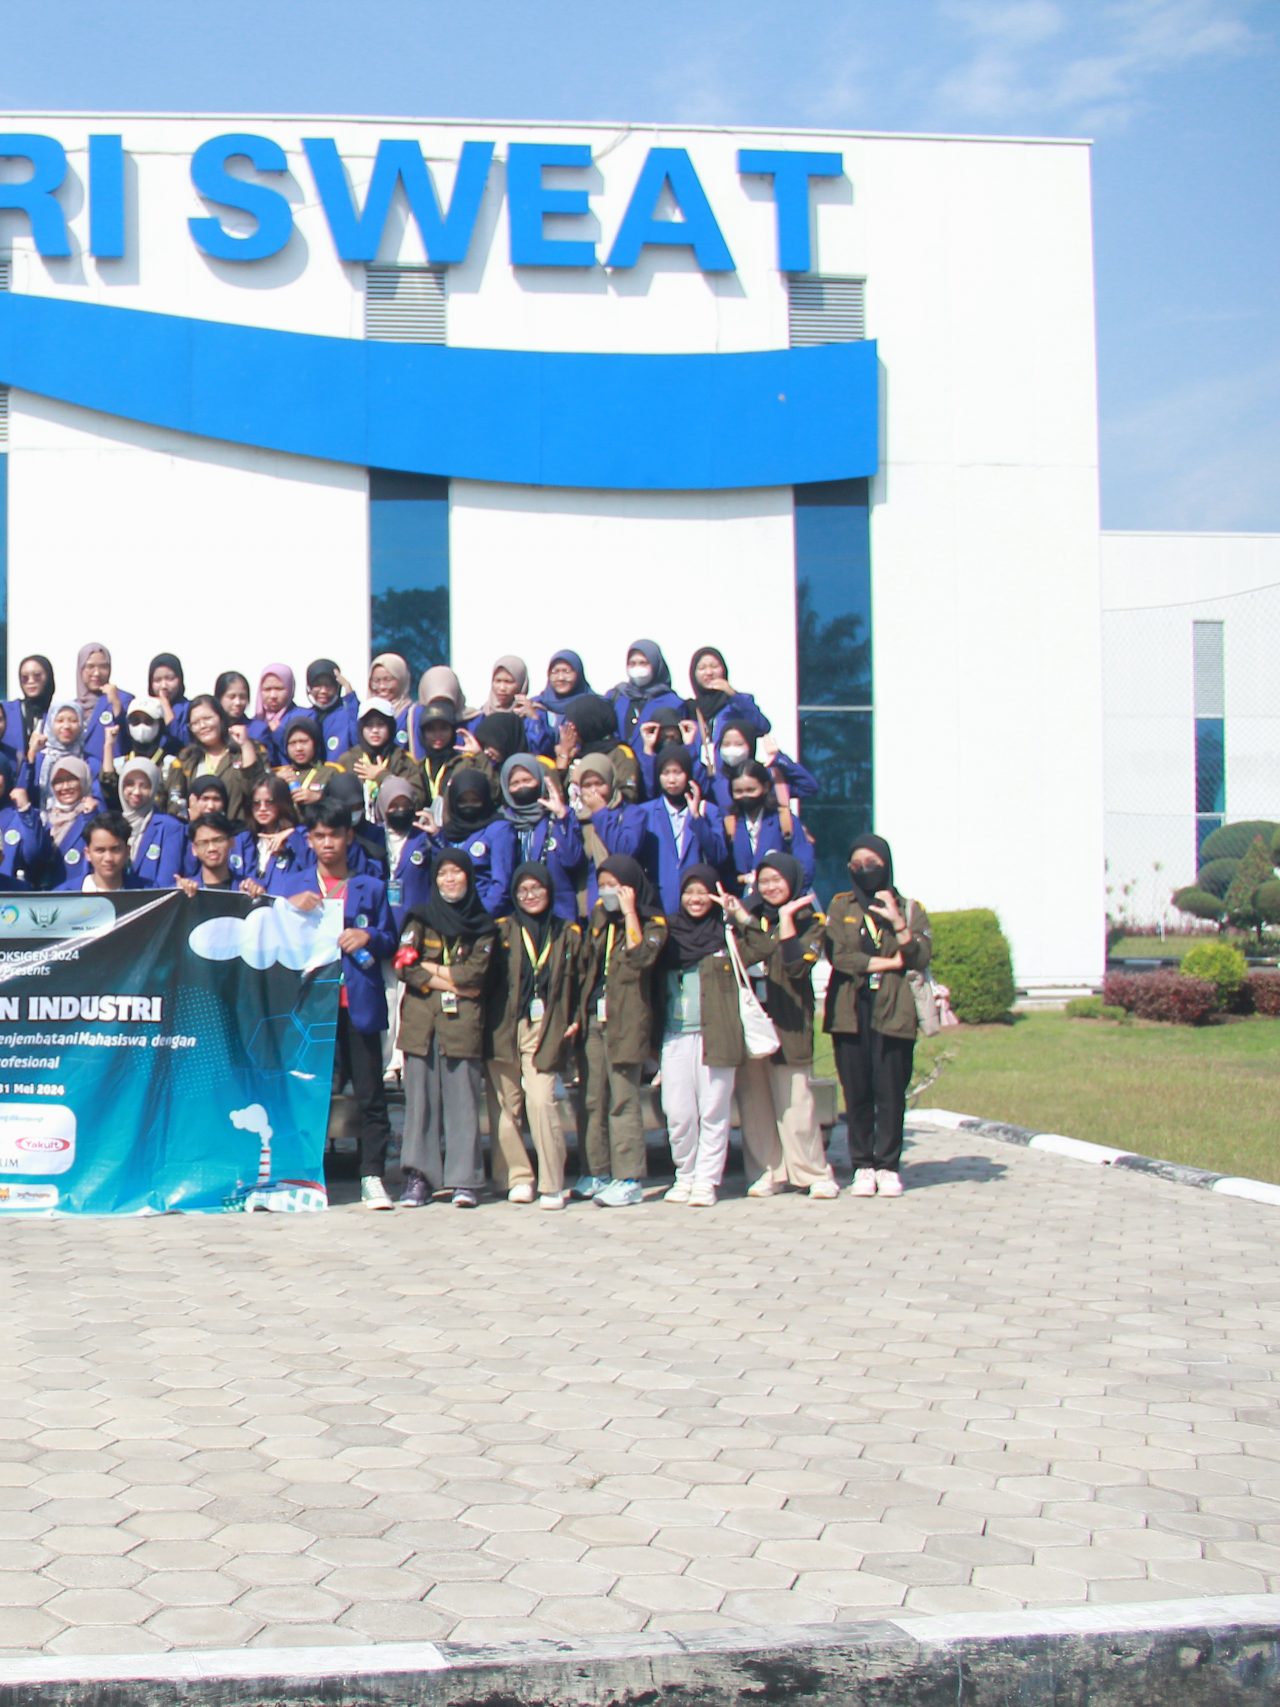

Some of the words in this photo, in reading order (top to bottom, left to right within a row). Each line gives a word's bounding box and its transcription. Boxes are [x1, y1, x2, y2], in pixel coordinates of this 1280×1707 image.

[187, 133, 844, 272] SWEAT
[51, 950, 80, 961] 2024
[27, 995, 162, 1021] INDUSTRI
[78, 1031, 147, 1047] Mahasiswa
[151, 1034, 197, 1050] dengan
[13, 1083, 34, 1094] Mei
[36, 1083, 65, 1096] 2024
